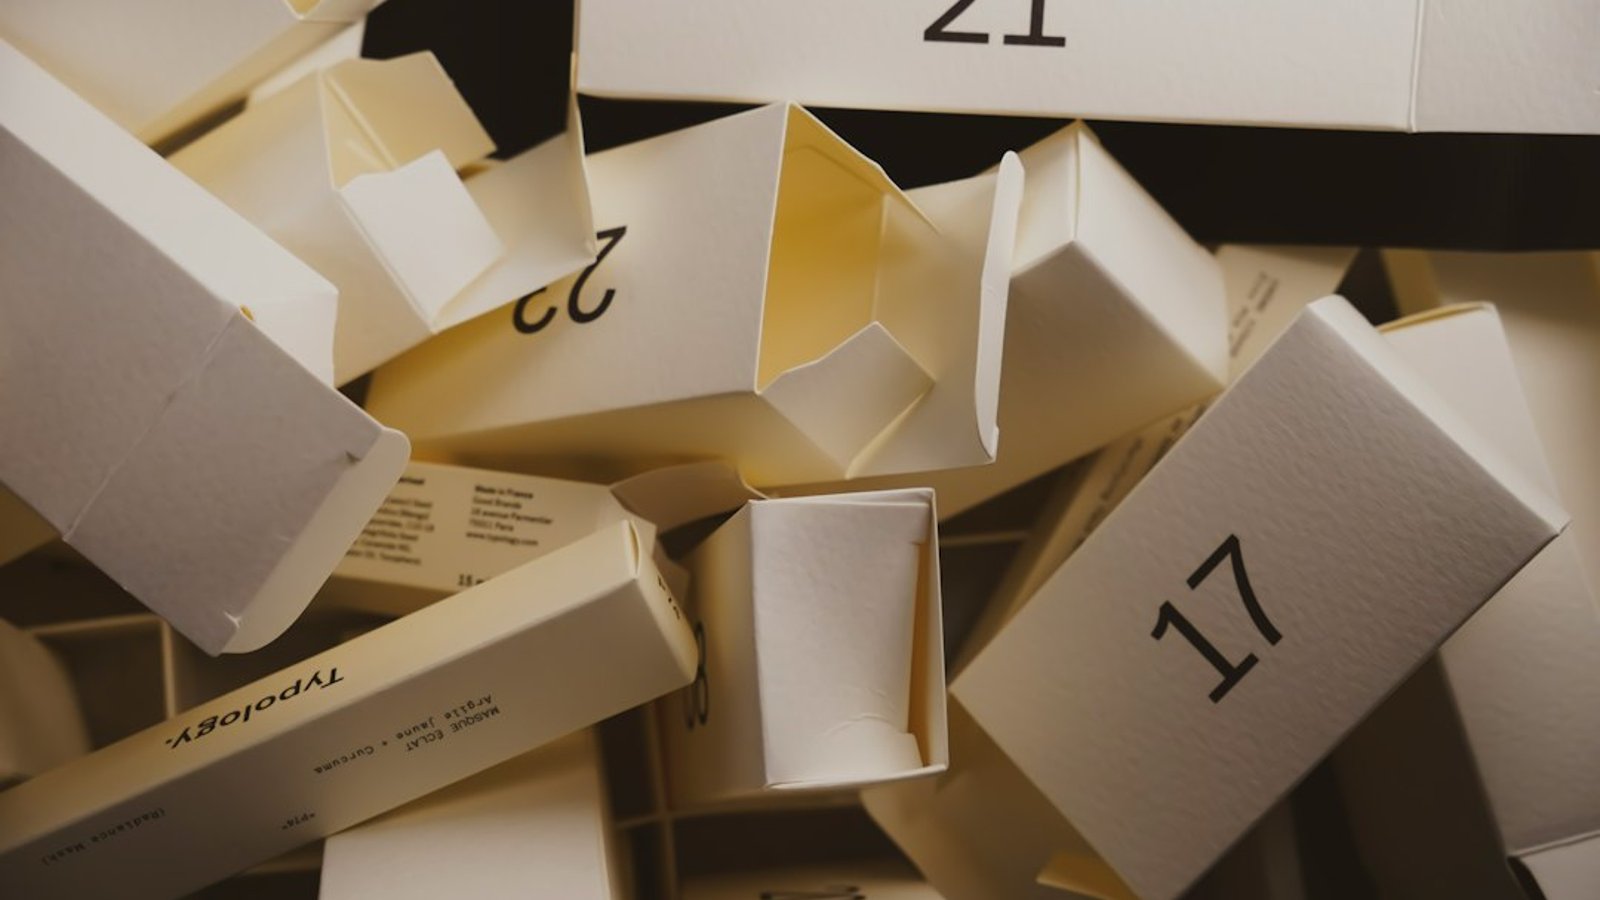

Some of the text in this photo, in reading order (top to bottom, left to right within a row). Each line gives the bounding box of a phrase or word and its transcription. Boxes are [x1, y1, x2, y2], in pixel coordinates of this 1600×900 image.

[1150, 534, 1283, 704] 17
[165, 667, 345, 749] Typology.
[444, 695, 492, 720] Argile
[450, 706, 500, 733] MASQUE
[396, 716, 436, 740] jaune
[313, 745, 375, 774] Curcuma
